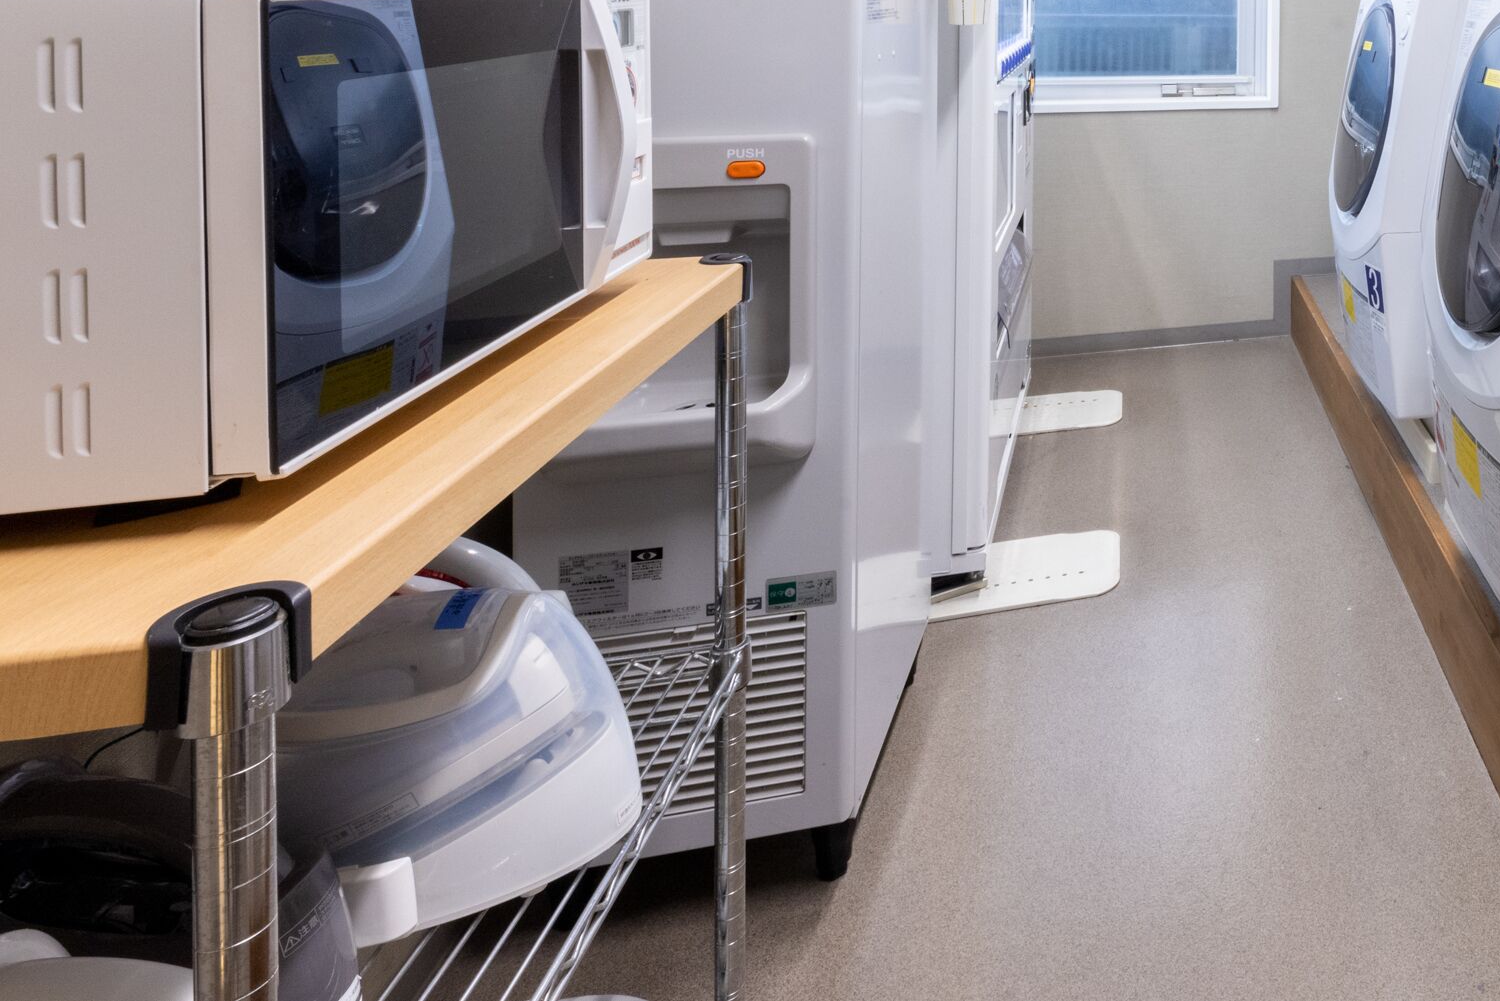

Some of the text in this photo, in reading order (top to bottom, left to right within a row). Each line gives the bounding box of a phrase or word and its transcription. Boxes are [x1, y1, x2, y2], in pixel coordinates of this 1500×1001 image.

[727, 148, 765, 158] PUSH
[1368, 268, 1380, 310] 3
[299, 914, 320, 939] 注意
